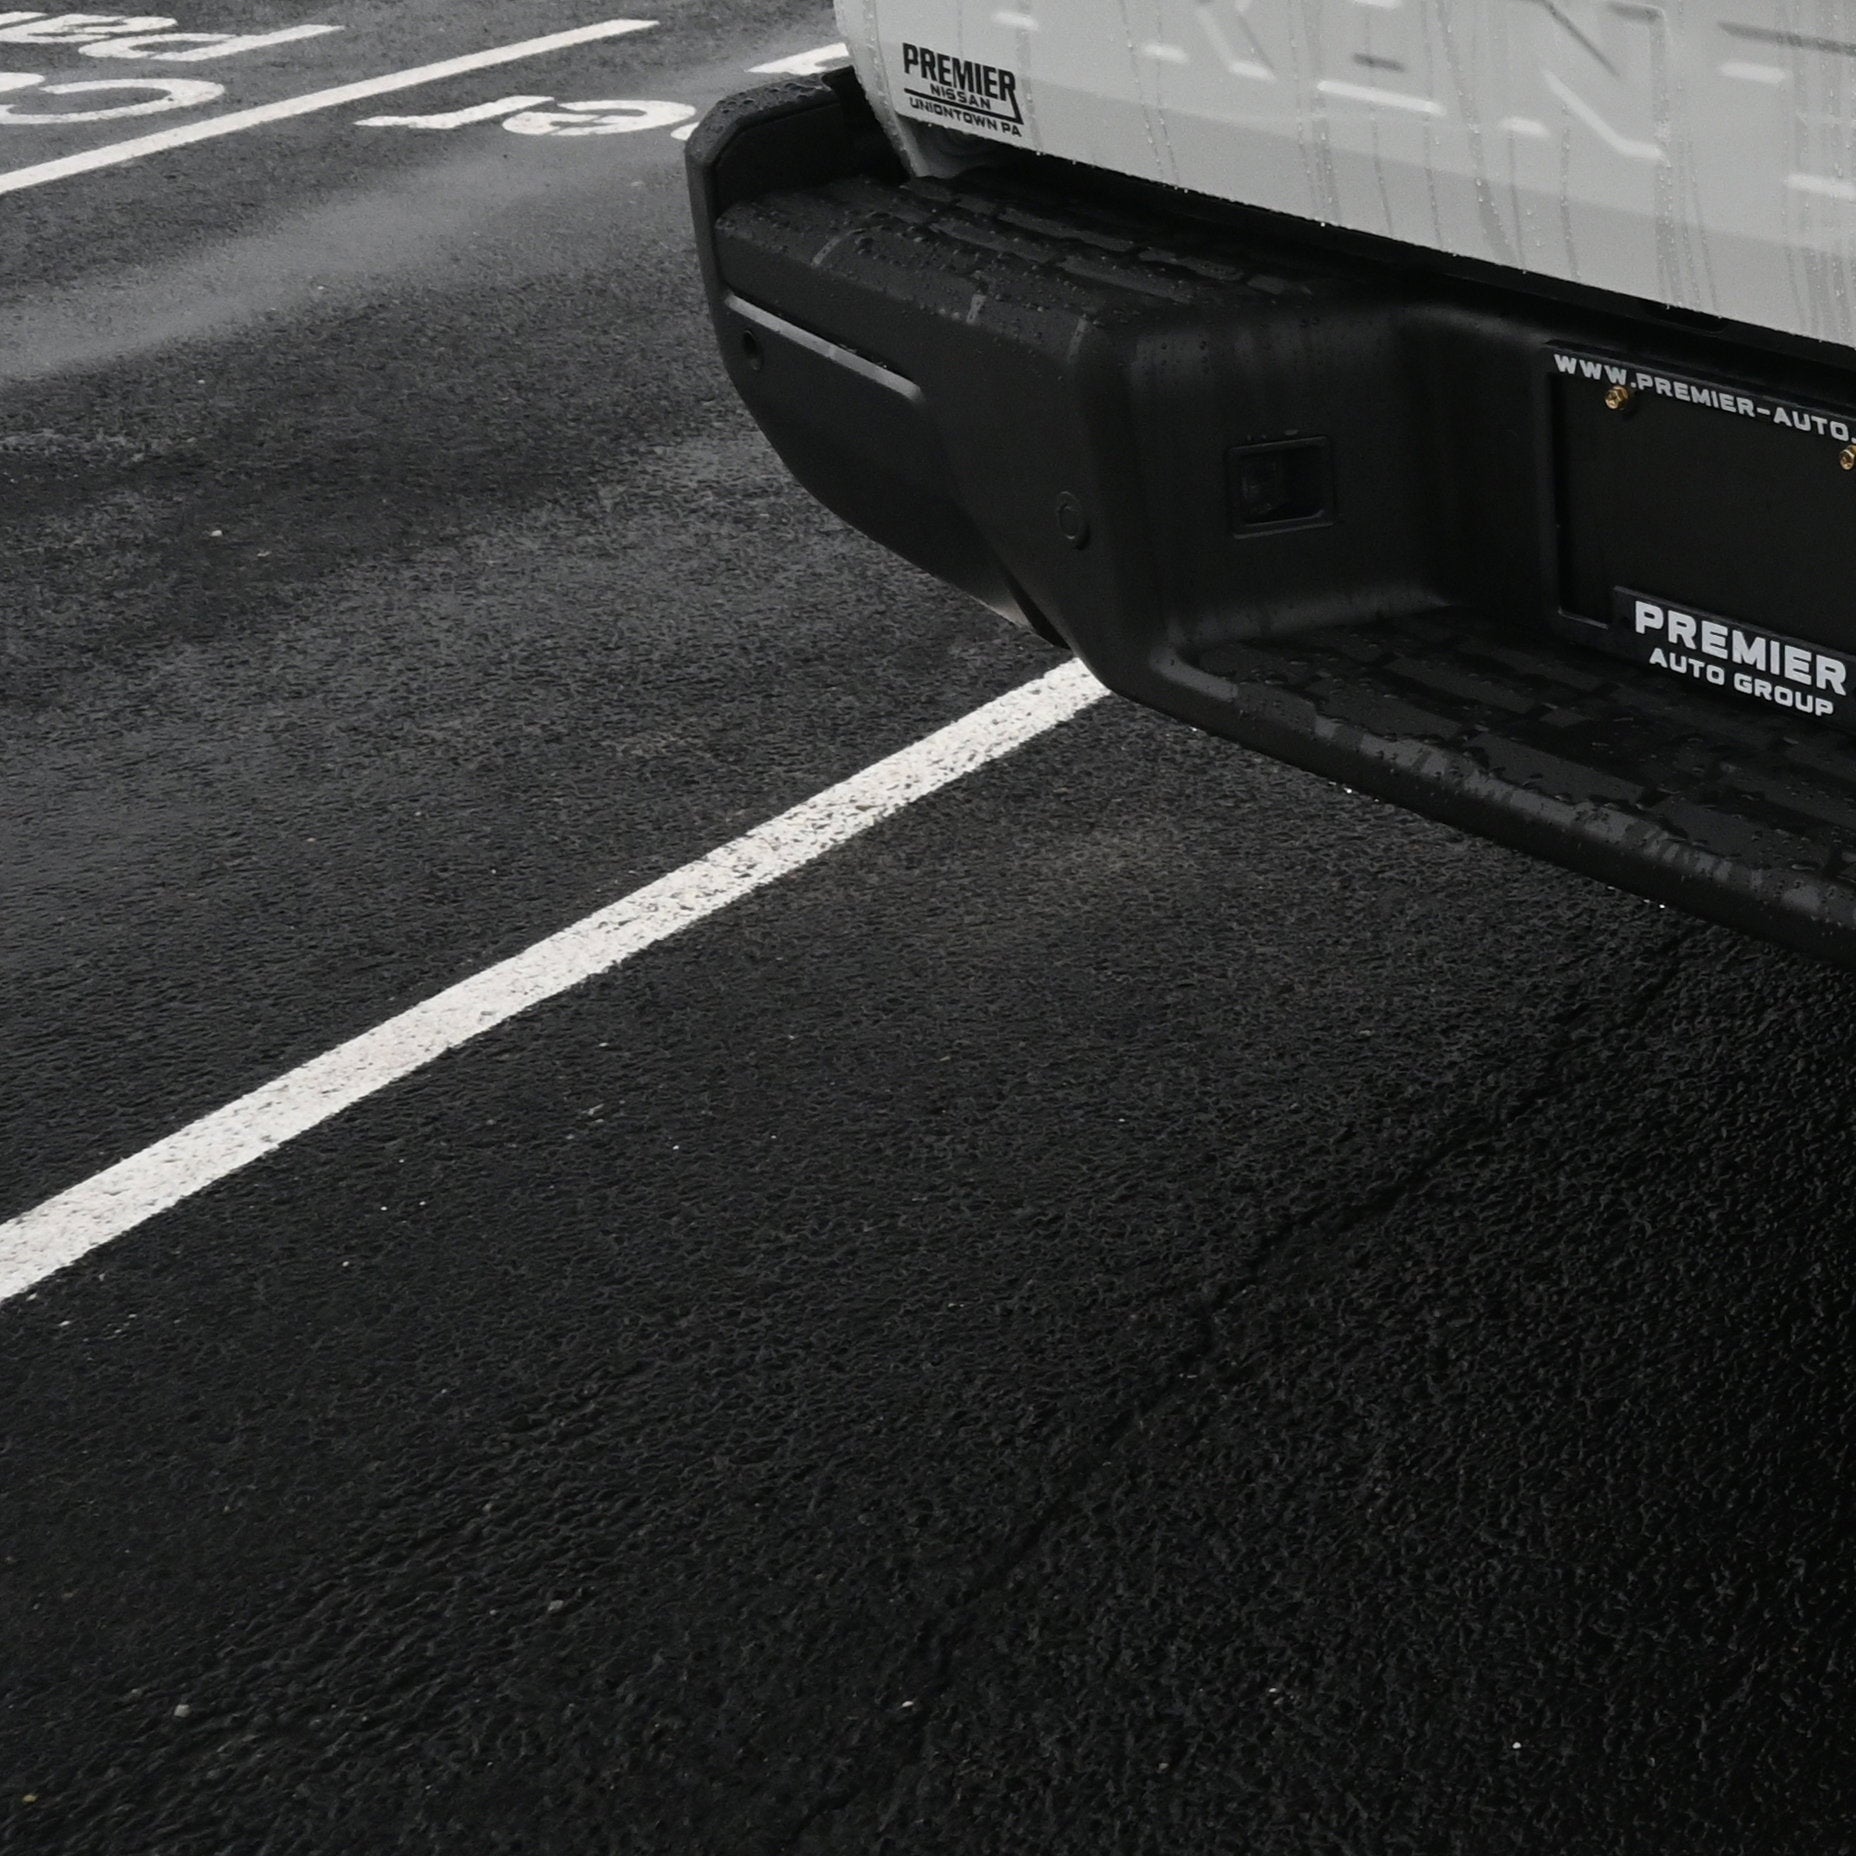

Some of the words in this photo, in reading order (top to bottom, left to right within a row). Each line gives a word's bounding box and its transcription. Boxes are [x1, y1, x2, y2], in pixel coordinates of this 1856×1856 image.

[0, 11, 346, 62] Pa
[902, 42, 1017, 102] PREMIER
[930, 83, 992, 111] NISSAN
[909, 96, 998, 132] UNIONTOWN
[1001, 122, 1023, 138] PA
[1634, 600, 1848, 696] PREMIER
[1649, 647, 1726, 686] AUTO
[1733, 673, 1835, 717] GROUP
